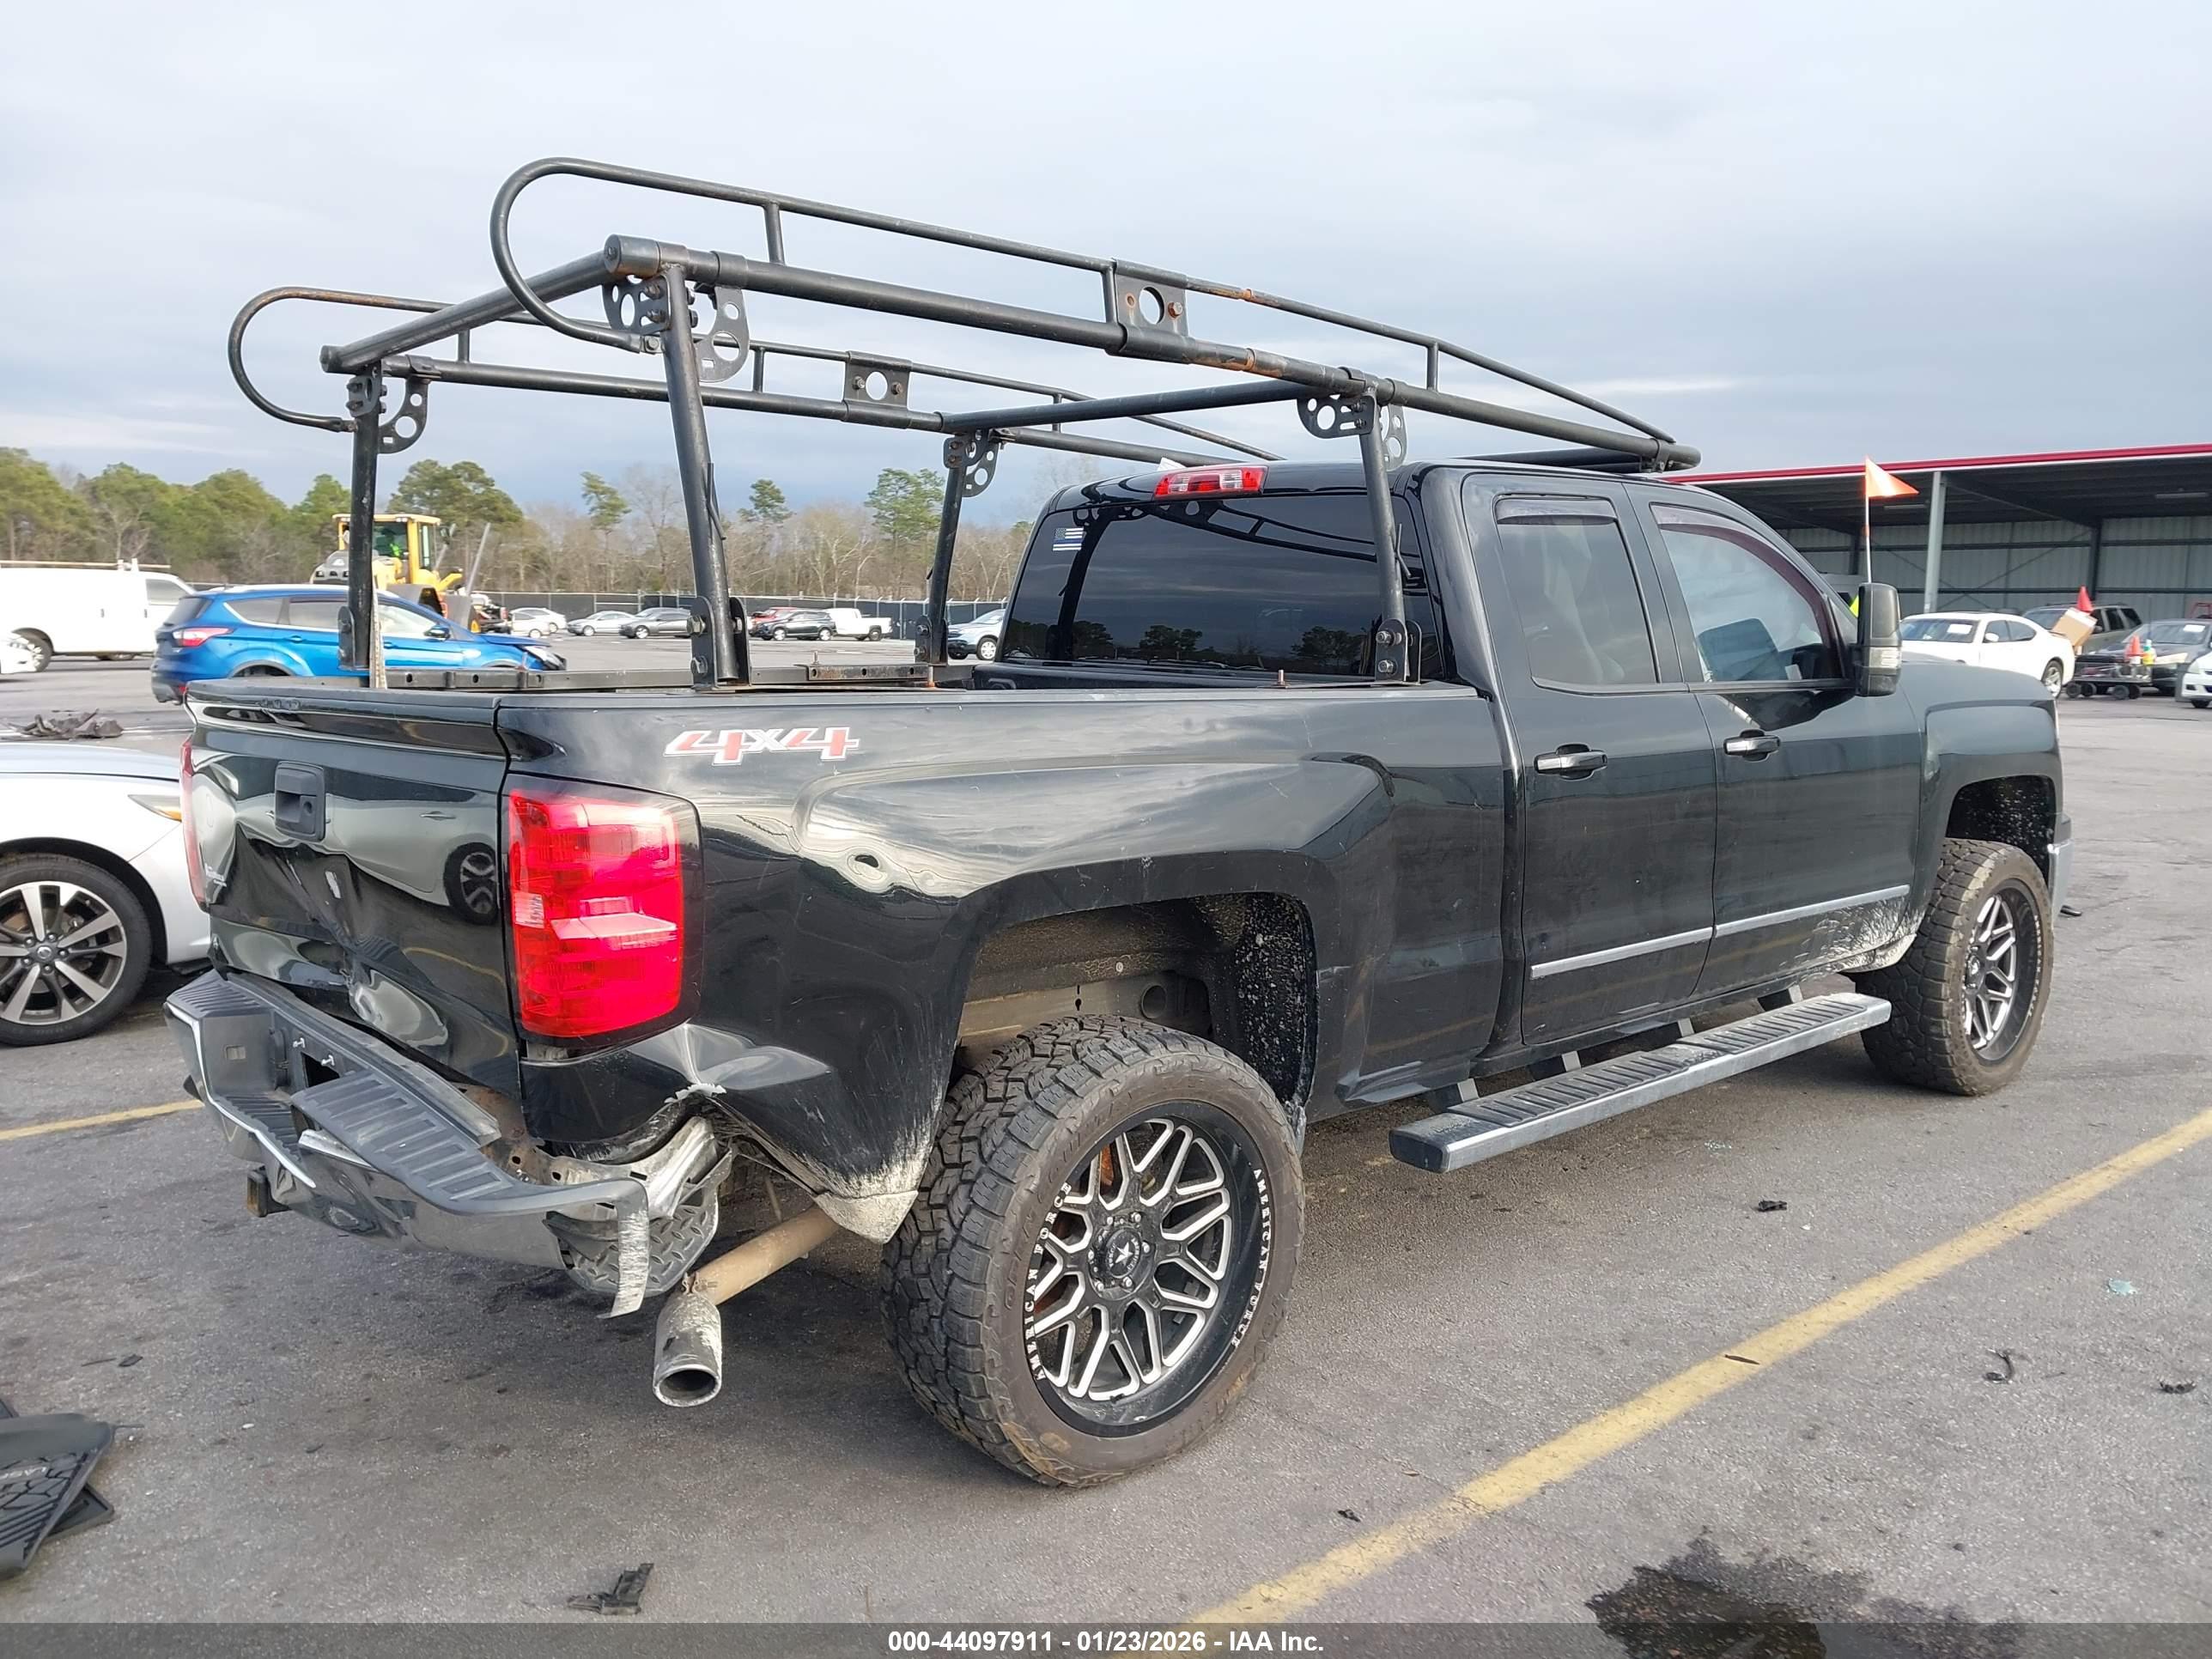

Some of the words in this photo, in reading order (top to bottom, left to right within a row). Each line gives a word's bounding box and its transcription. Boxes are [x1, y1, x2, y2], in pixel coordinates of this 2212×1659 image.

[1034, 1182, 1072, 1255] FORCE
[1254, 1168, 1272, 1272] AMERICAN
[1024, 1268, 1046, 1381] AMERICAN
